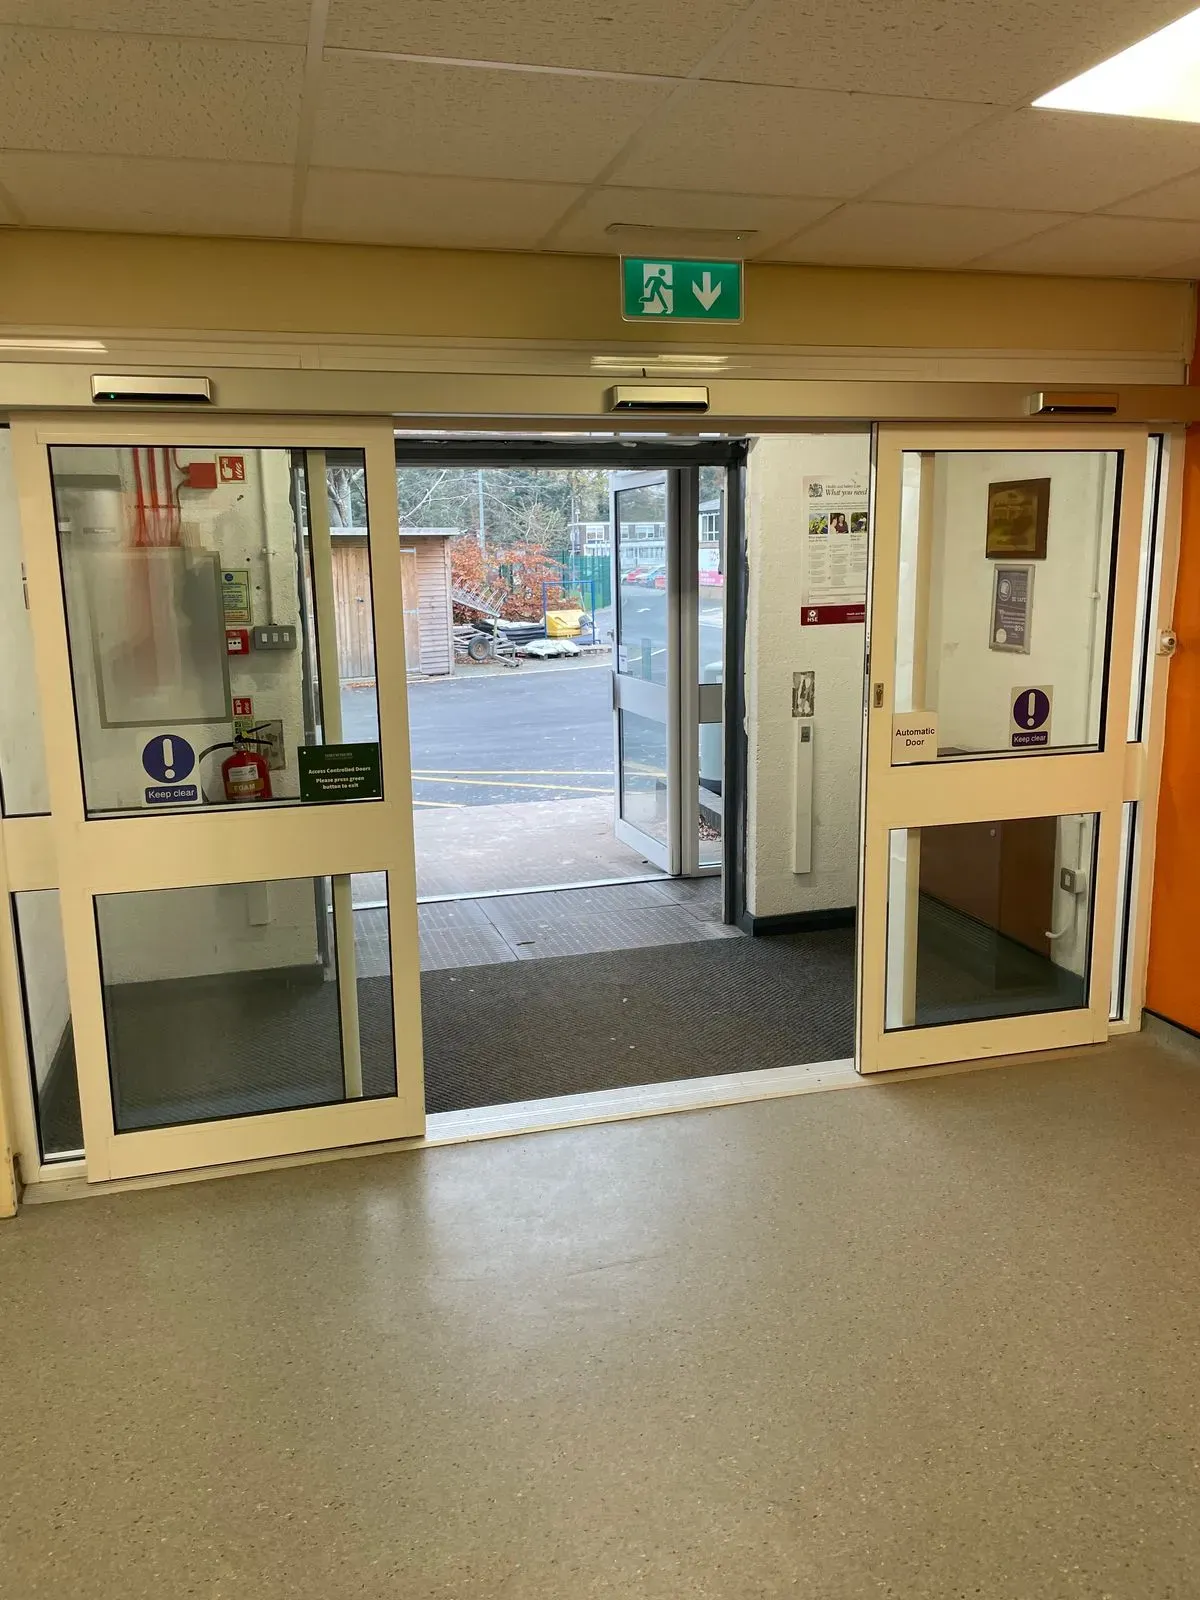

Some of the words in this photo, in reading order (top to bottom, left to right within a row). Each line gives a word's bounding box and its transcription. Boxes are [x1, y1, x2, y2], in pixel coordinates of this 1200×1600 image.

[853, 488, 868, 496] need
[895, 727, 936, 737] Automatic
[905, 738, 925, 746] Door
[1013, 735, 1030, 744] Keep
[1030, 734, 1046, 742] clear
[326, 766, 355, 774] Controlled
[233, 783, 256, 791] FOAM
[148, 790, 171, 799] Keep
[173, 788, 195, 797] clear
